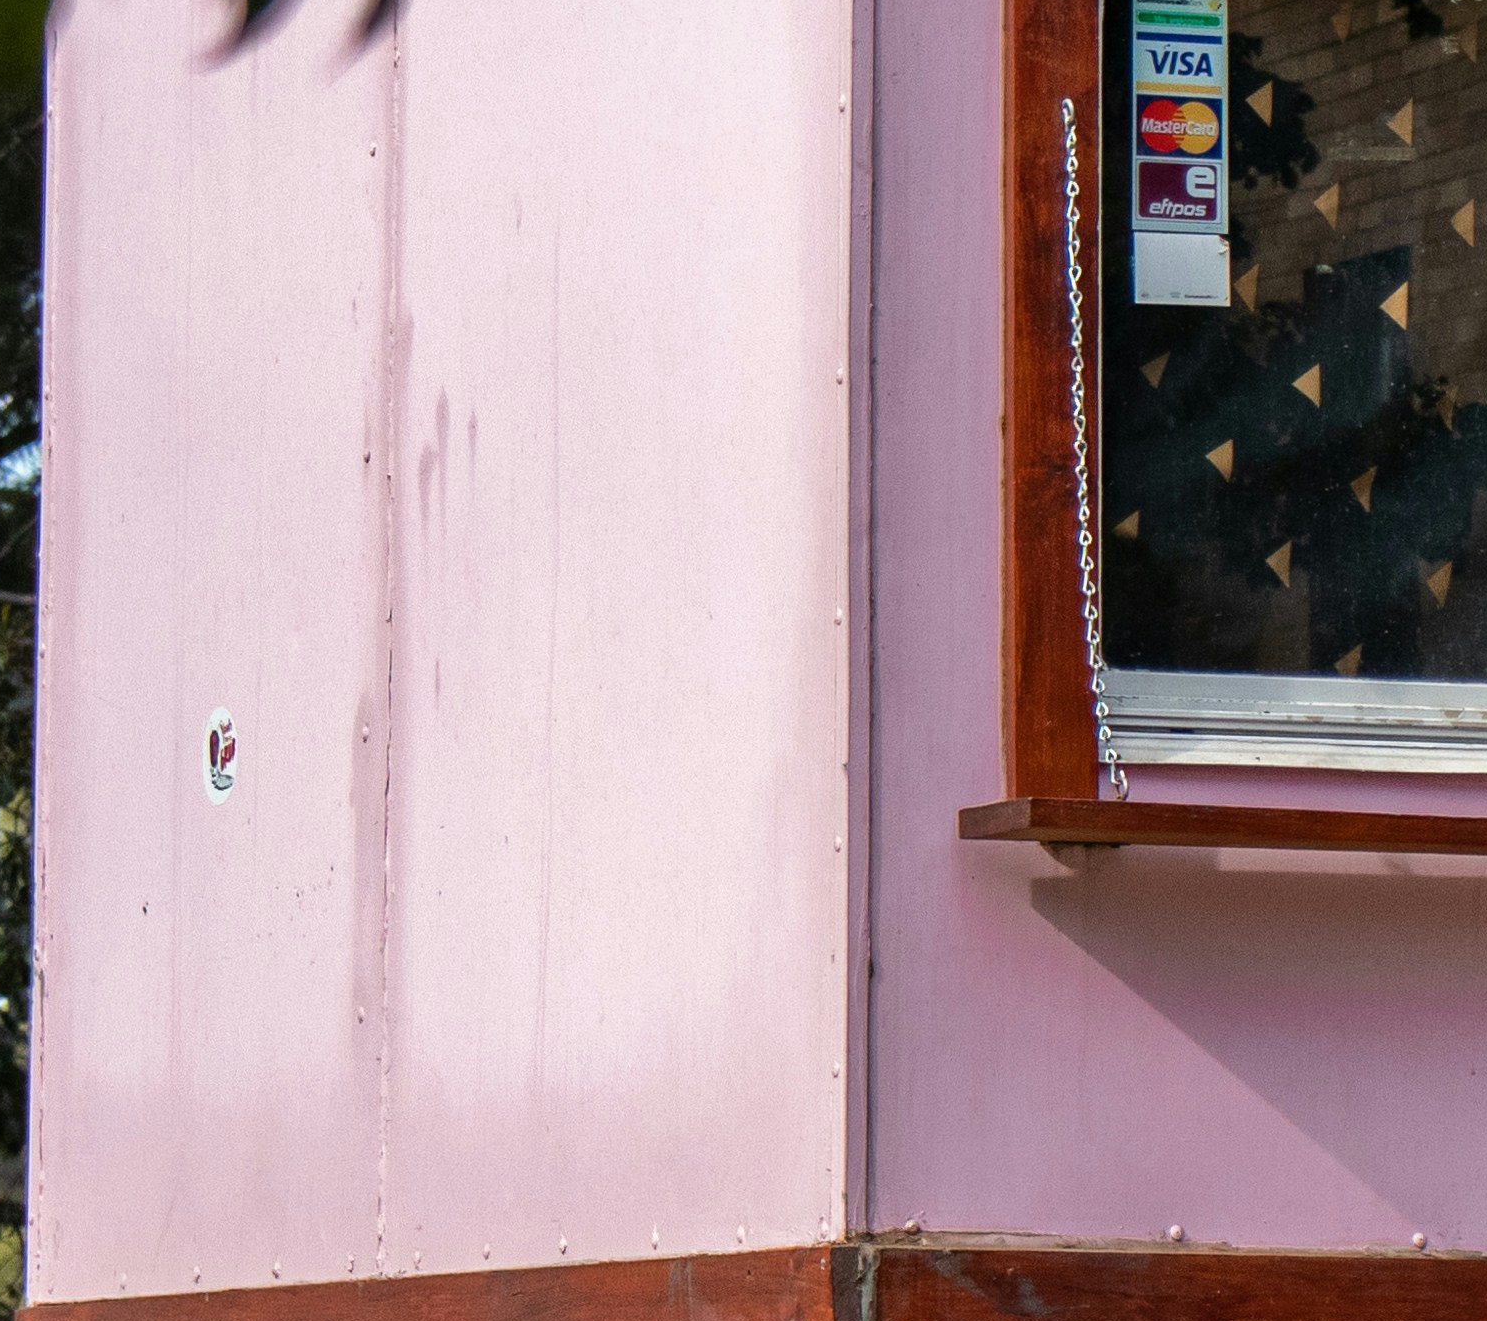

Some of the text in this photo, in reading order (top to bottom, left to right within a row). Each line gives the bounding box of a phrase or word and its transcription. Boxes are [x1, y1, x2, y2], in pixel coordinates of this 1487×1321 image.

[1145, 49, 1213, 77] VISA
[1141, 117, 1218, 137] MasterCard
[1149, 198, 1207, 218] eftpos
